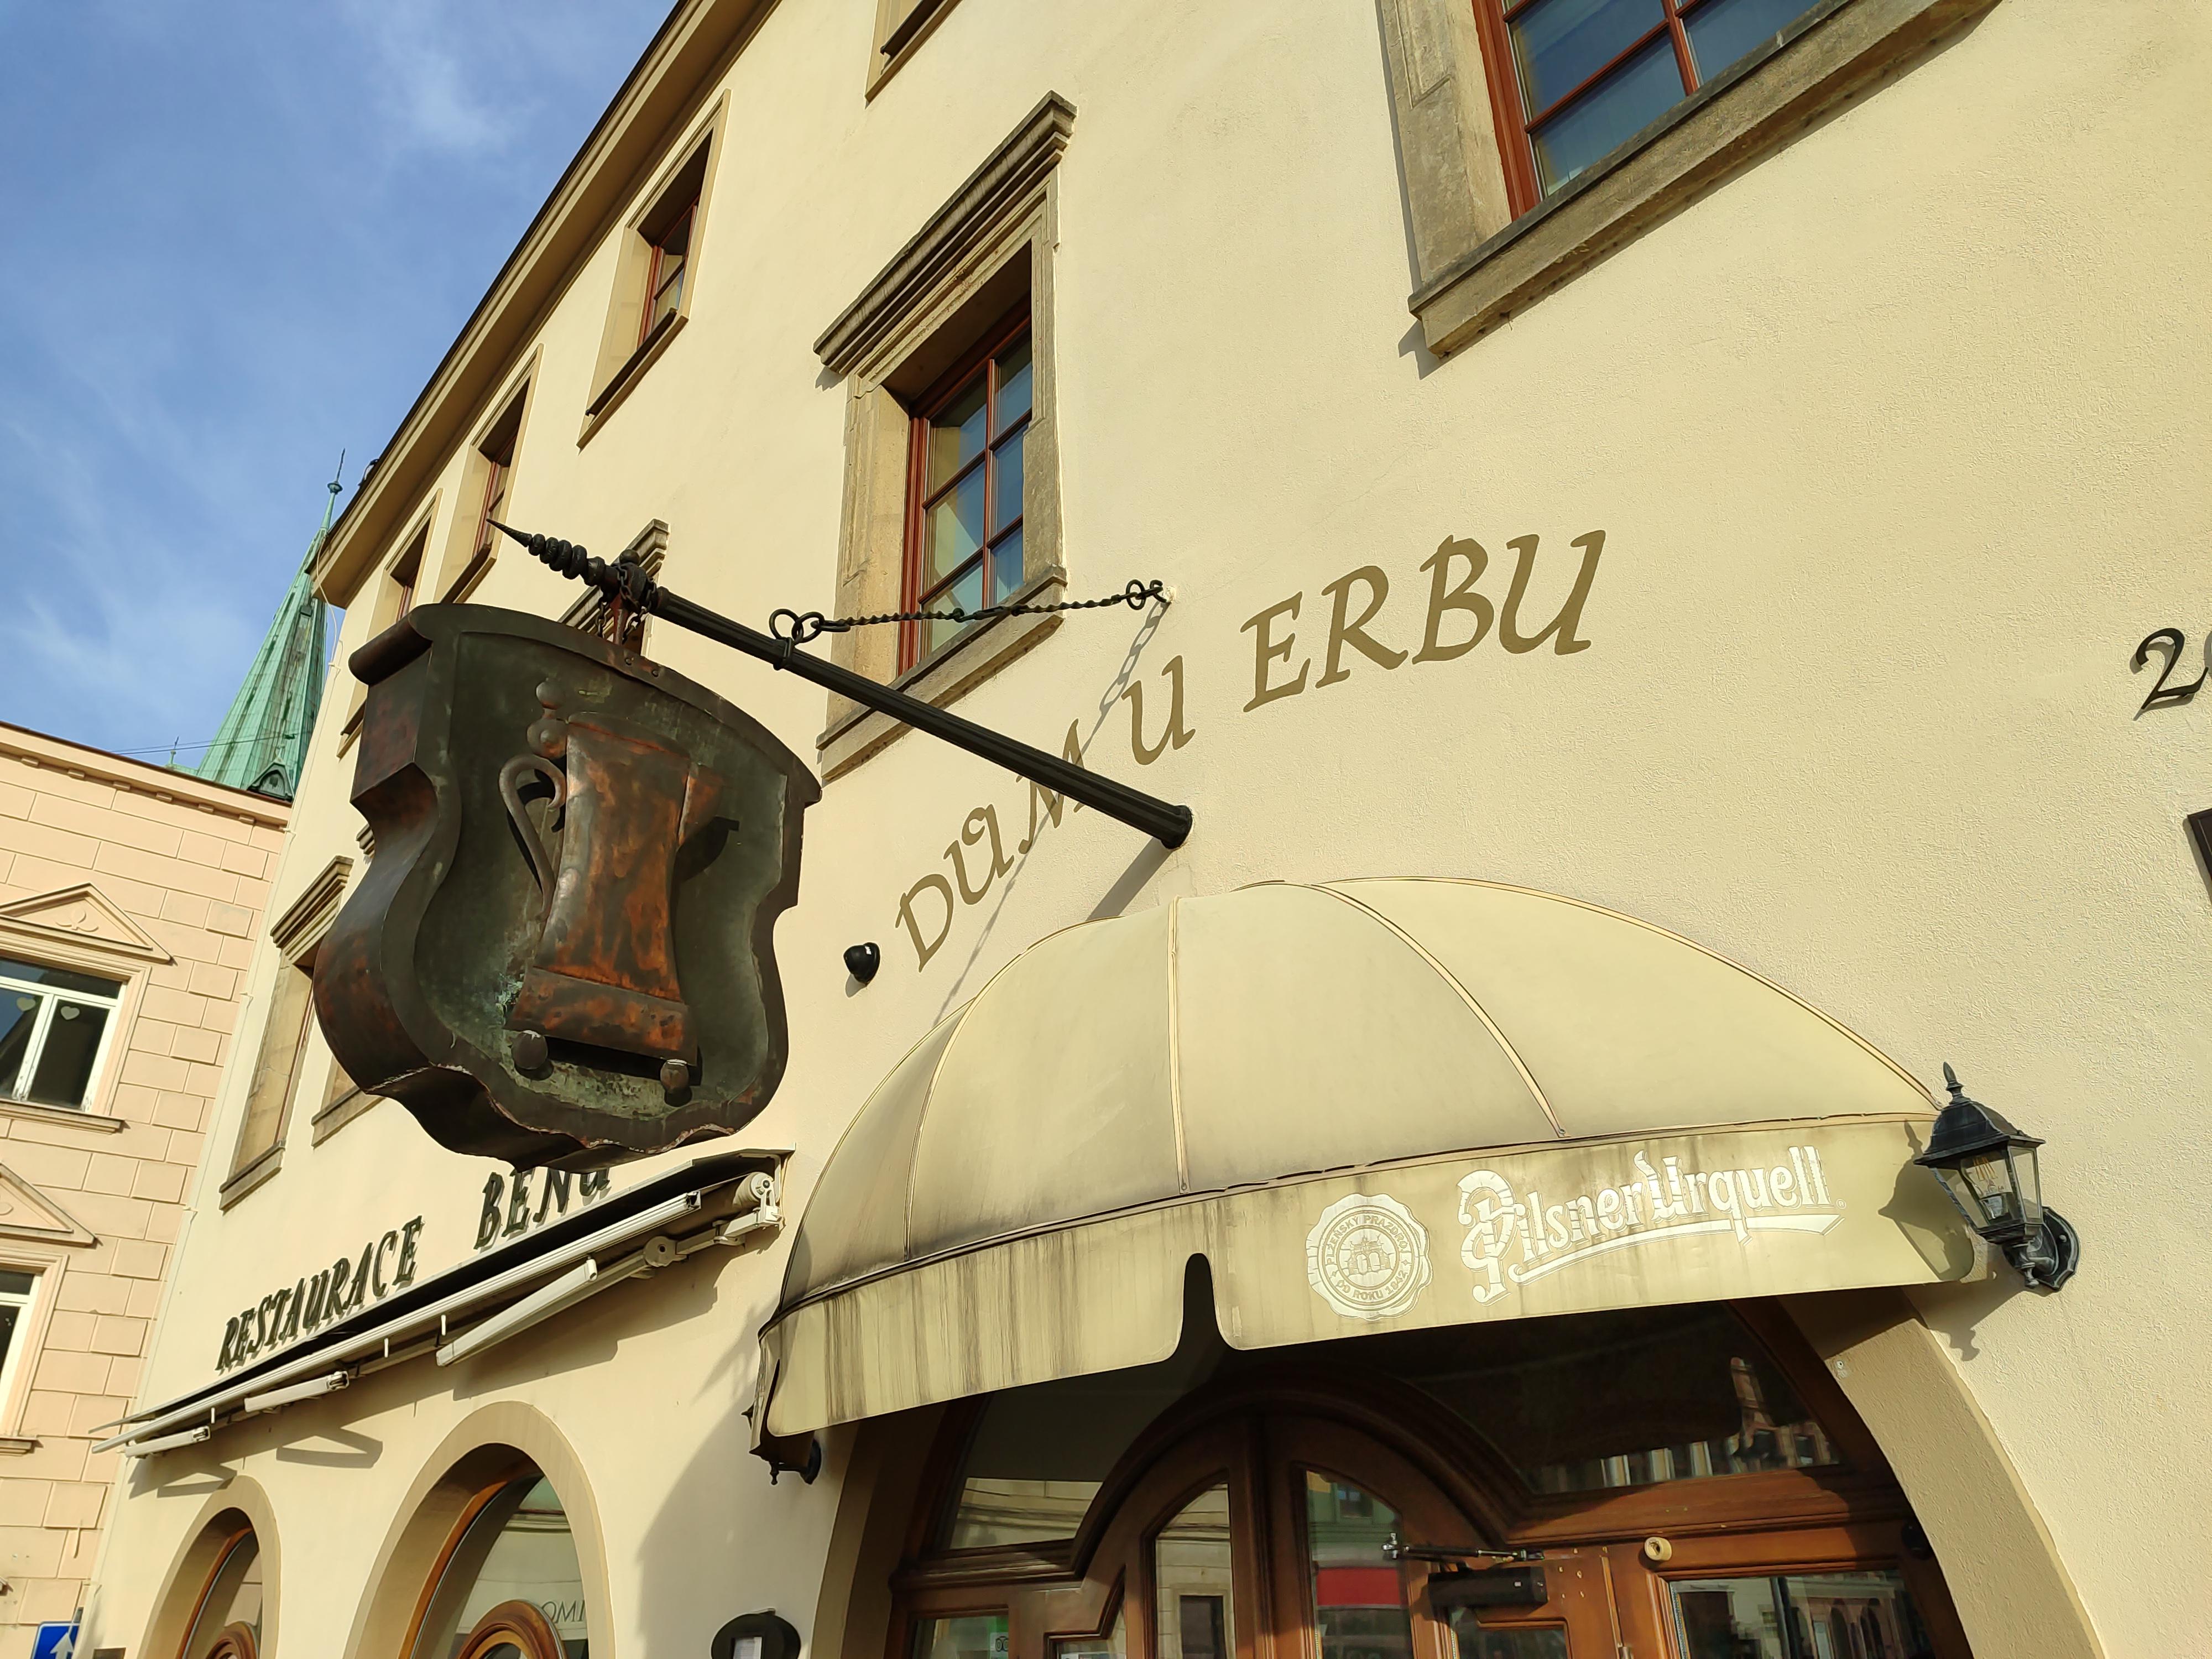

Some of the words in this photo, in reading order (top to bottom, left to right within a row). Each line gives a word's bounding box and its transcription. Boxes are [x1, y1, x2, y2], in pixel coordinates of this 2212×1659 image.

[1121, 655, 1196, 766] U
[1240, 530, 1606, 713] ERBU
[215, 1215, 422, 1371] RESTAURACE
[1336, 1280, 1351, 1293] OD
[1353, 1290, 1384, 1300] ROKU
[1385, 1270, 1408, 1295] 1842
[1363, 1214, 1411, 1254] PRAZDROJ
[1457, 1169, 1643, 1304] Pilsner
[1633, 1145, 1833, 1245] Urquell
